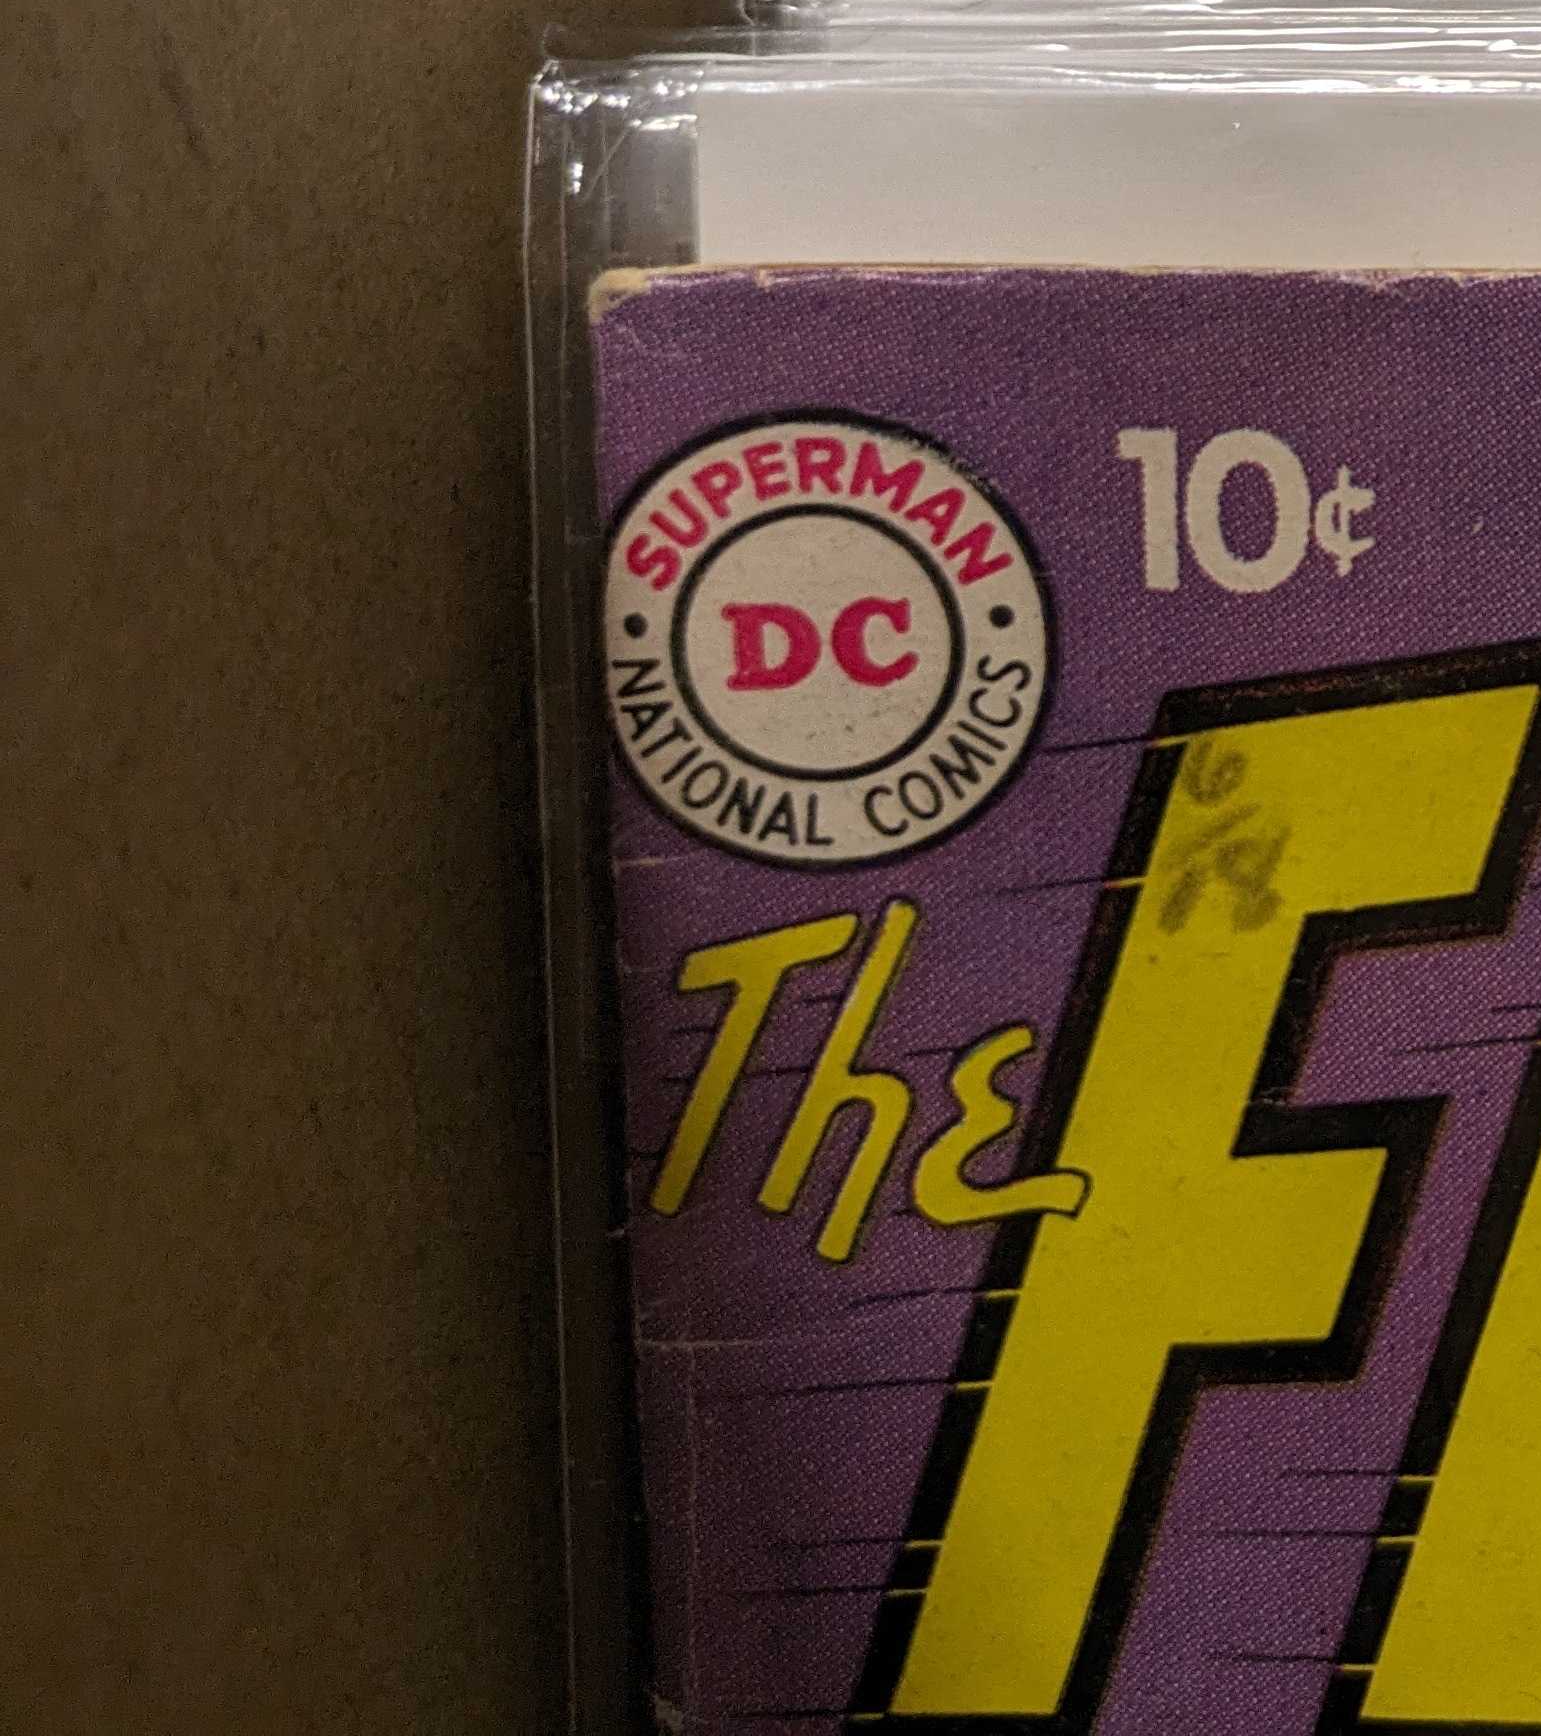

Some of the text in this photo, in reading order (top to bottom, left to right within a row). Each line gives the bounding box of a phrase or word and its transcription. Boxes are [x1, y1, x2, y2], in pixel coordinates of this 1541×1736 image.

[625, 437, 1011, 592] SUPERMAN
[1115, 426, 1376, 594] 10¢
[721, 597, 920, 692] DC
[612, 654, 1032, 847] NATIONAL COMICS
[649, 895, 1092, 1264] The
